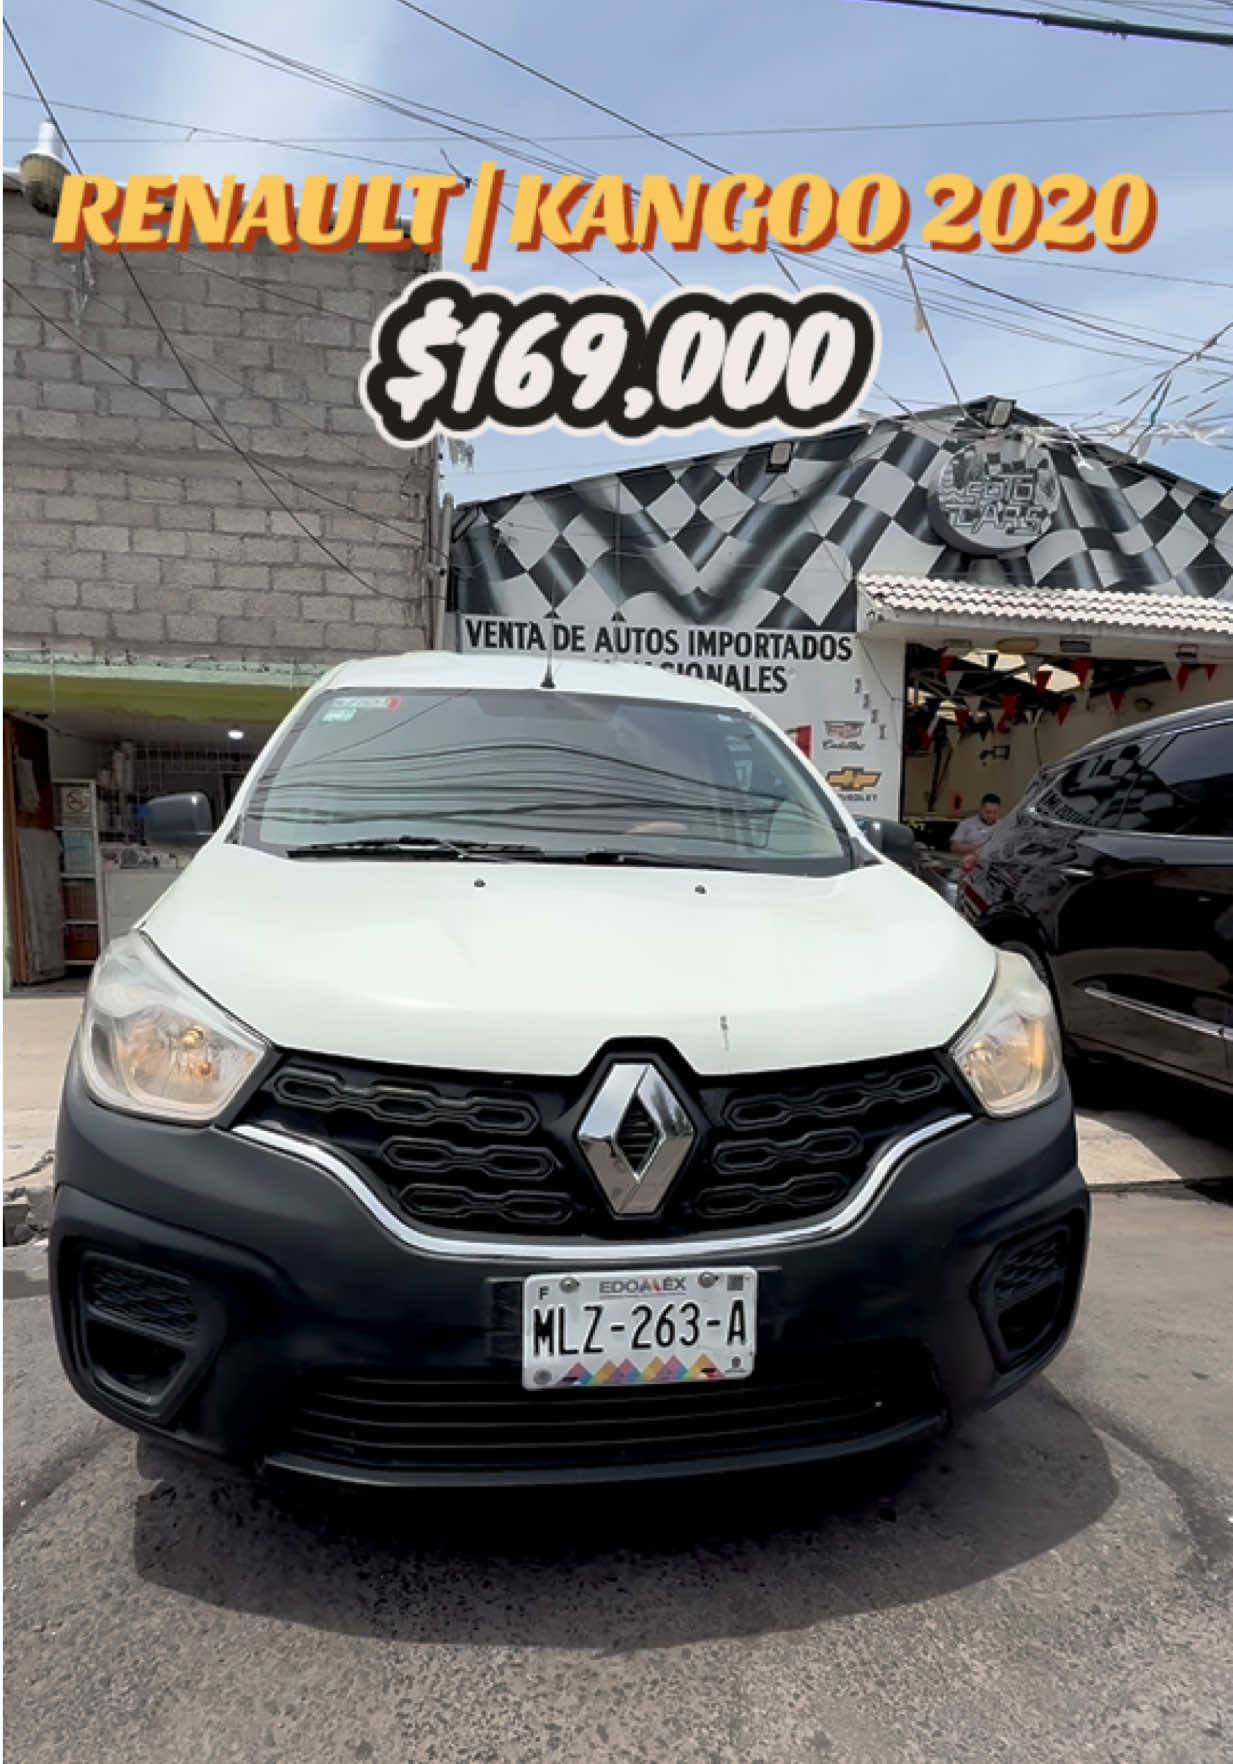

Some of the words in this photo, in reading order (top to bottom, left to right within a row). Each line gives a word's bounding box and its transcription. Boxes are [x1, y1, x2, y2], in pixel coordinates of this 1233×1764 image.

[465, 619, 546, 650] VENTA
[553, 624, 586, 652] DE
[595, 626, 680, 656] AUTOS
[688, 630, 853, 662] IMPORTADOS
[538, 1287, 549, 1300] F
[533, 1300, 746, 1356] MLZ-263-A
